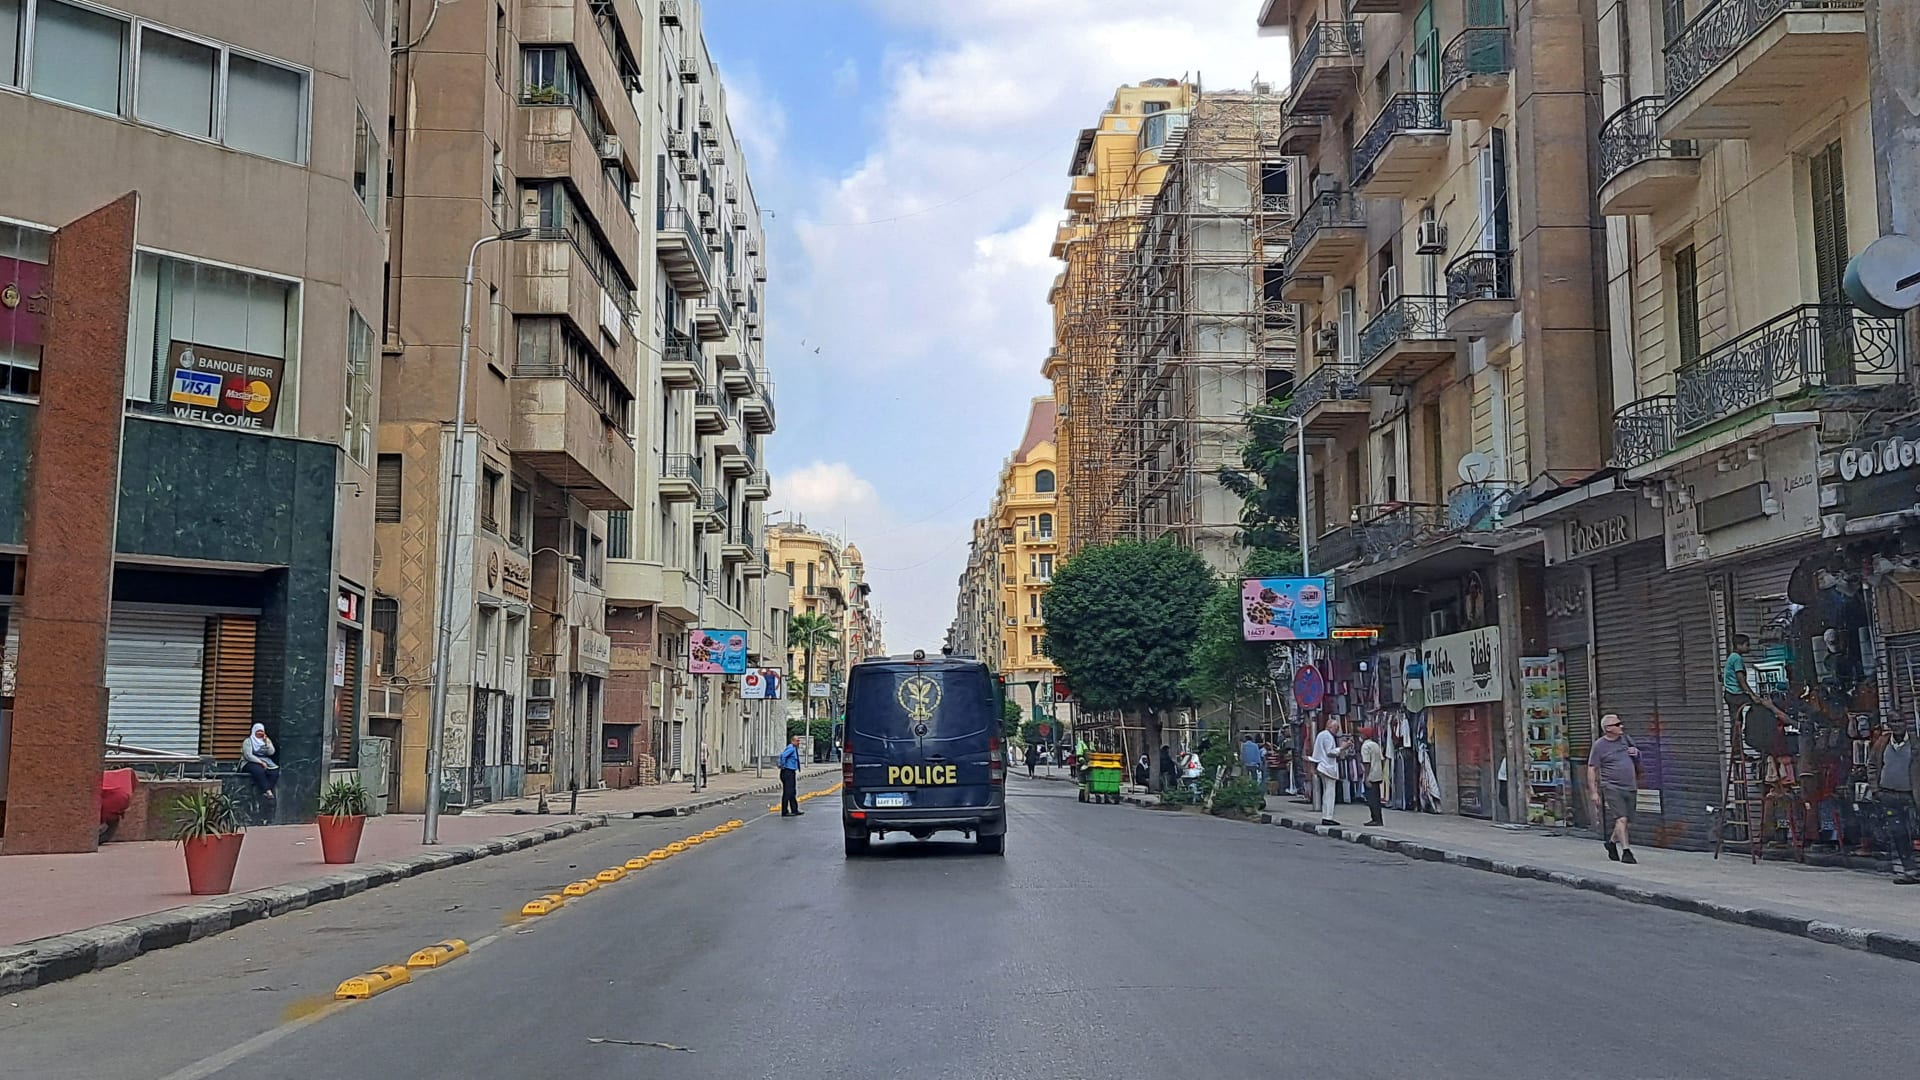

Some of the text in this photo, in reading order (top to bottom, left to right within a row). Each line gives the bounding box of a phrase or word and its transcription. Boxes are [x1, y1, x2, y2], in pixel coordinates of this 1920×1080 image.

[199, 358, 273, 379] BANQUE MISR
[181, 380, 212, 397] VISA
[173, 407, 263, 428] WELCOME
[888, 765, 957, 785] POLICE
